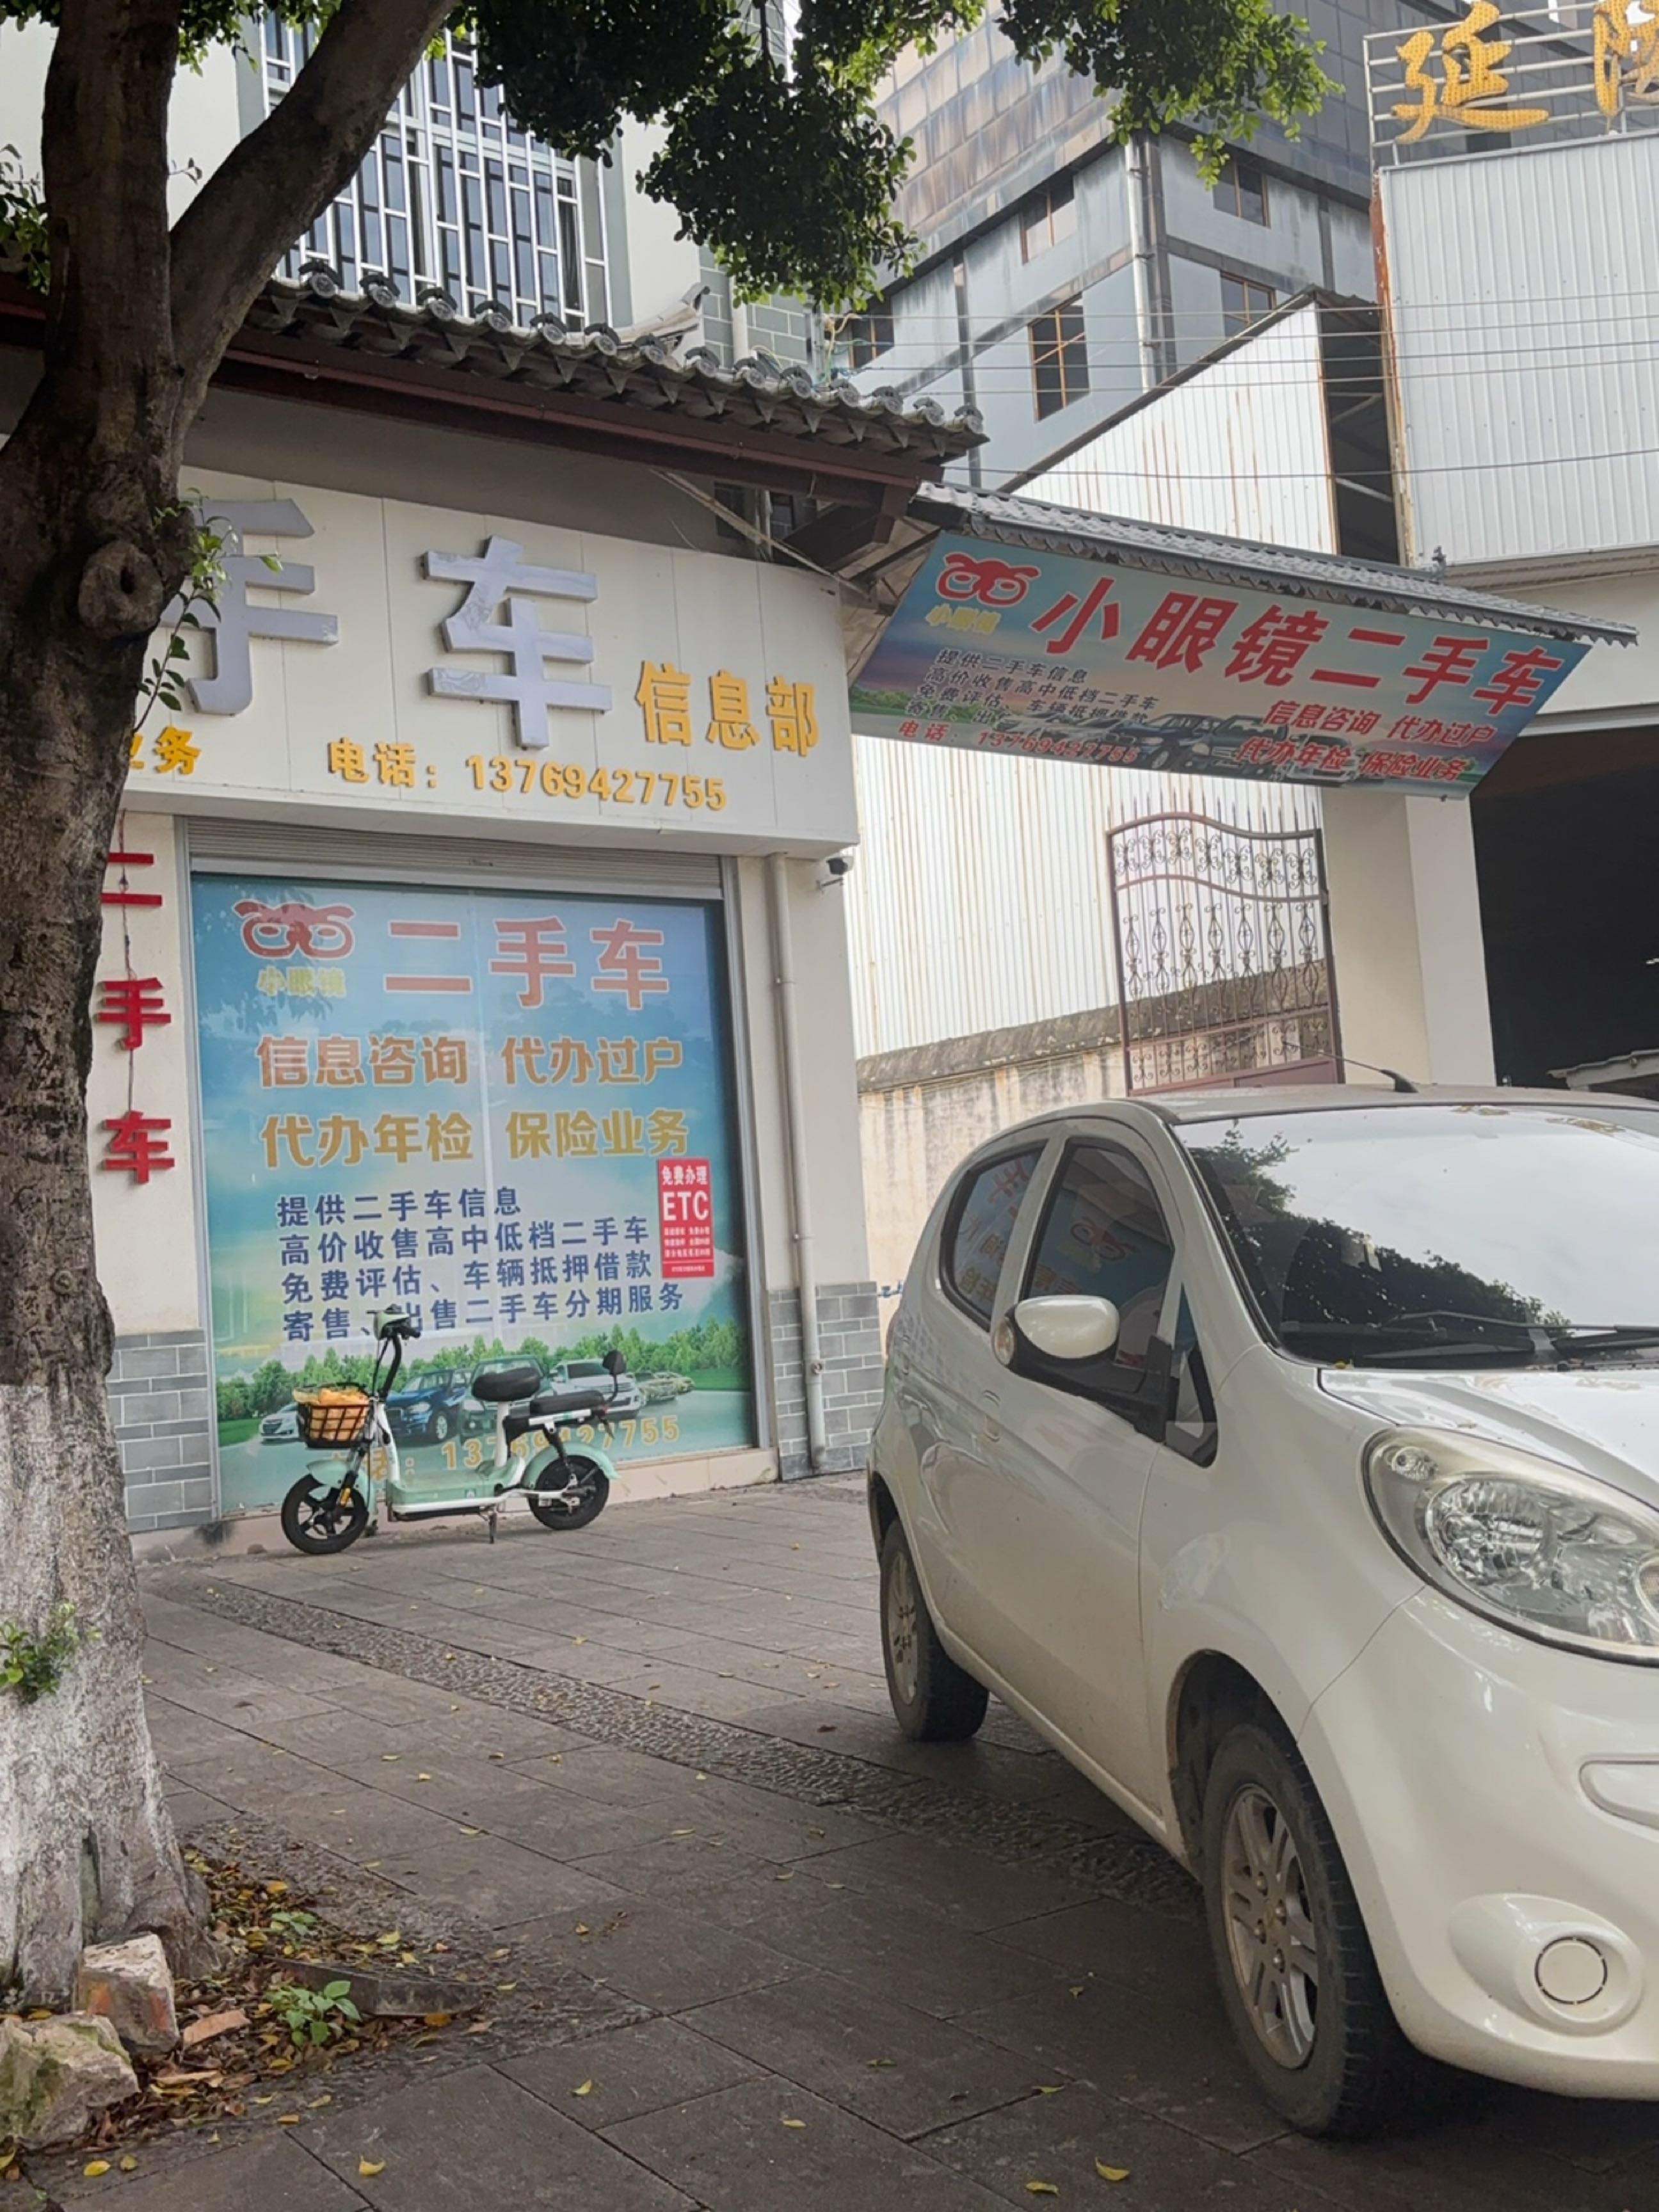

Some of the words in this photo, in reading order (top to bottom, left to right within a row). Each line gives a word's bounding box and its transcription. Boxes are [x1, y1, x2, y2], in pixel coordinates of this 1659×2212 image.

[935, 647, 1089, 684] 提供二手车信息
[1028, 576, 1567, 717] 小眼镜二手车
[634, 660, 819, 757] 信息部
[1262, 700, 1381, 735] 信息咨询
[1387, 714, 1498, 748] 代办过户
[328, 736, 439, 789] 电话：
[465, 754, 727, 811] 13769427755
[977, 732, 1140, 764] 13769427755
[1235, 735, 1352, 771] 代办年检
[1358, 749, 1470, 781] 保险业务
[383, 915, 669, 1010] 二手车
[95, 852, 175, 1185] 二手车
[256, 1035, 469, 1089] 信息咨询
[501, 1036, 684, 1085] 代办过户
[260, 1110, 474, 1169] 代办年检
[505, 1107, 689, 1159] 保险业务
[276, 1186, 521, 1228] 提供二手车信息
[663, 1190, 709, 1221] ETC
[278, 1216, 649, 1267] 高价收售高中低档二手车
[463, 1250, 652, 1291] 车辆抵押借款
